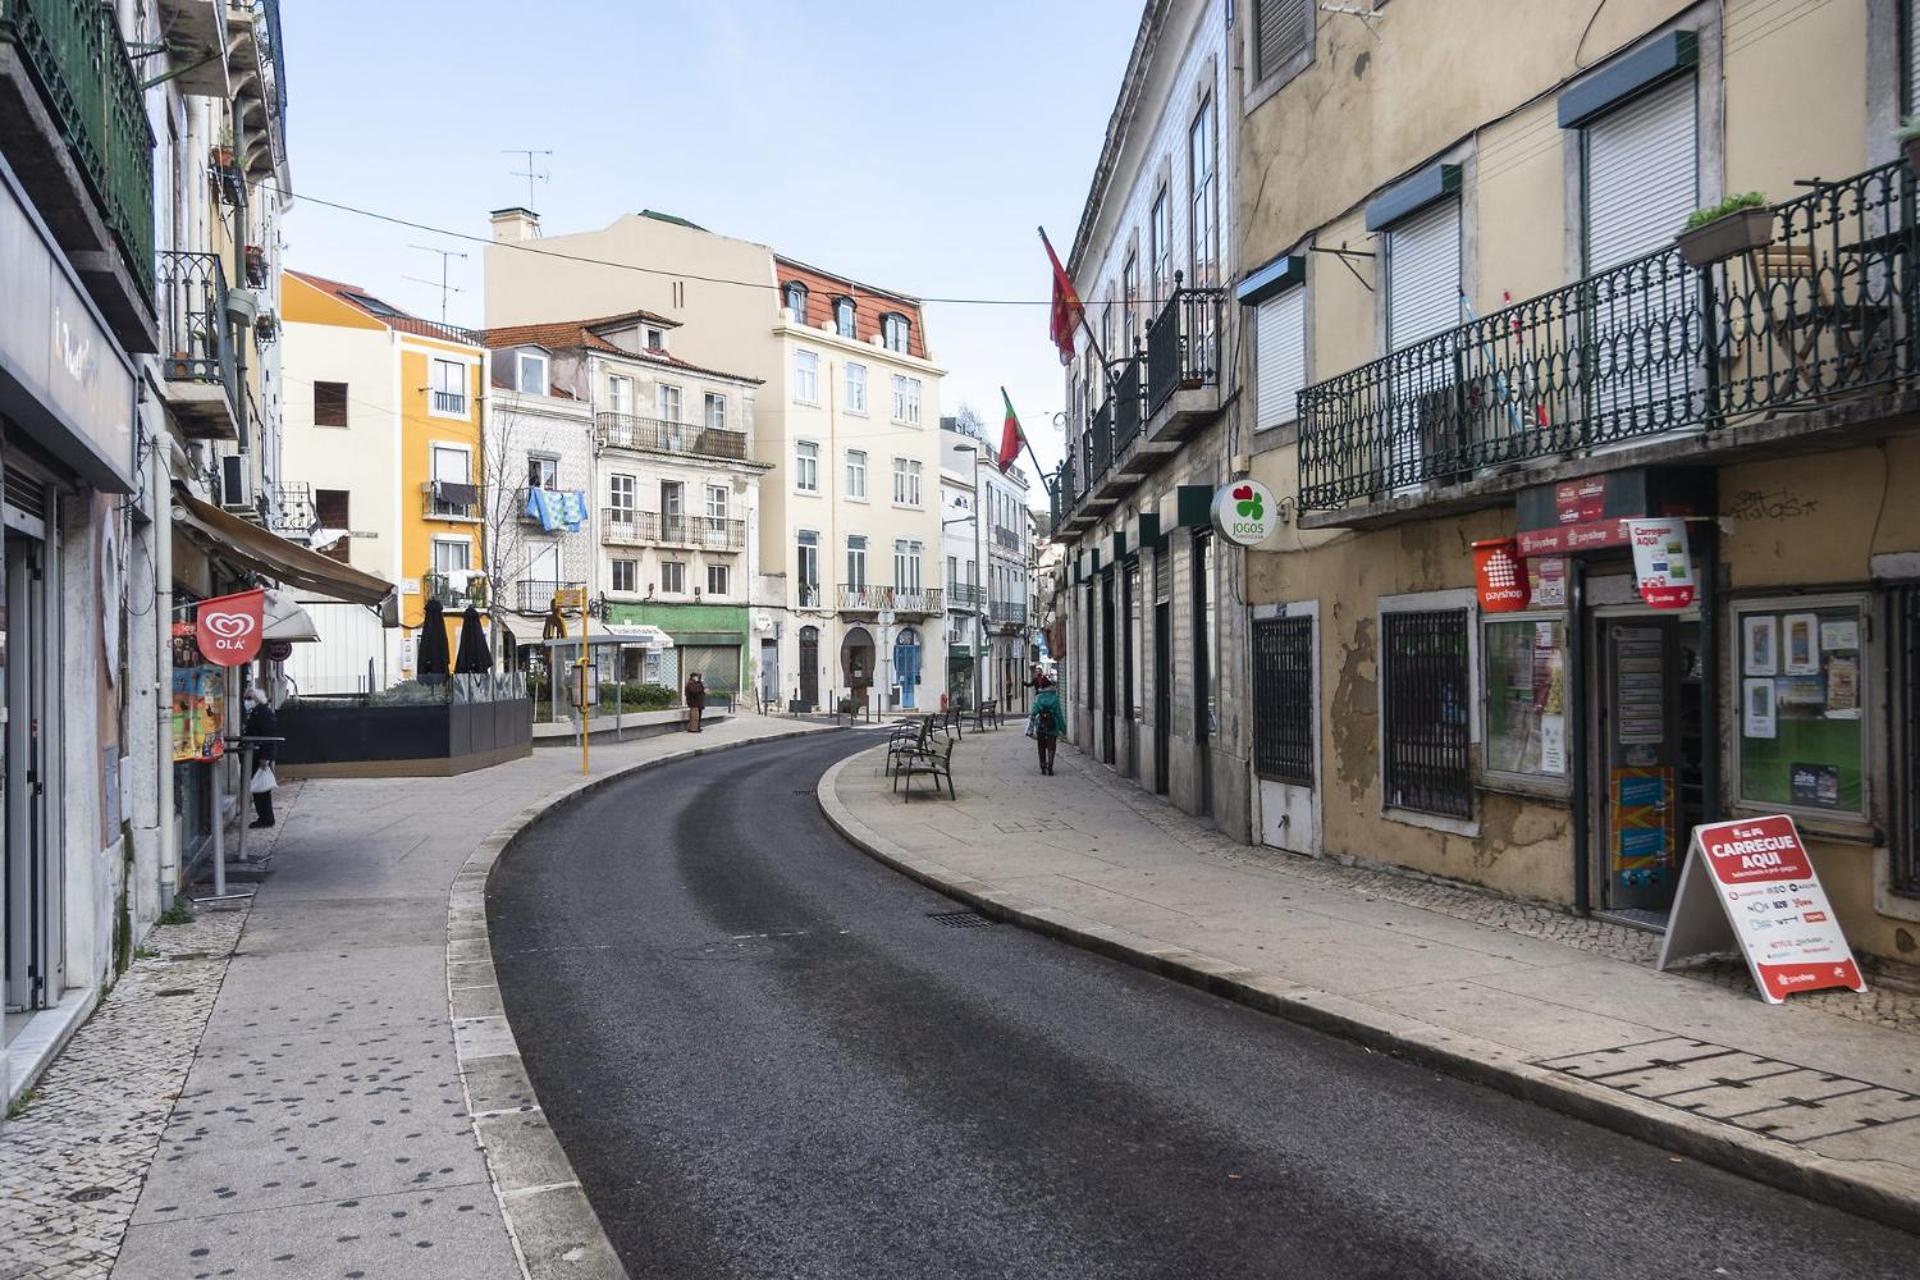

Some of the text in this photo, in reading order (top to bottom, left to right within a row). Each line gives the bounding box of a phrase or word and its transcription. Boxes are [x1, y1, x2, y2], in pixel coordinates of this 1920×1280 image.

[1232, 523, 1264, 535] JOGOS
[1578, 530, 1607, 543] payshop
[1636, 537, 1658, 546] AQUI
[1485, 589, 1524, 603] payshop
[1712, 836, 1796, 857] CARREGUE
[1742, 852, 1782, 868] AQUI
